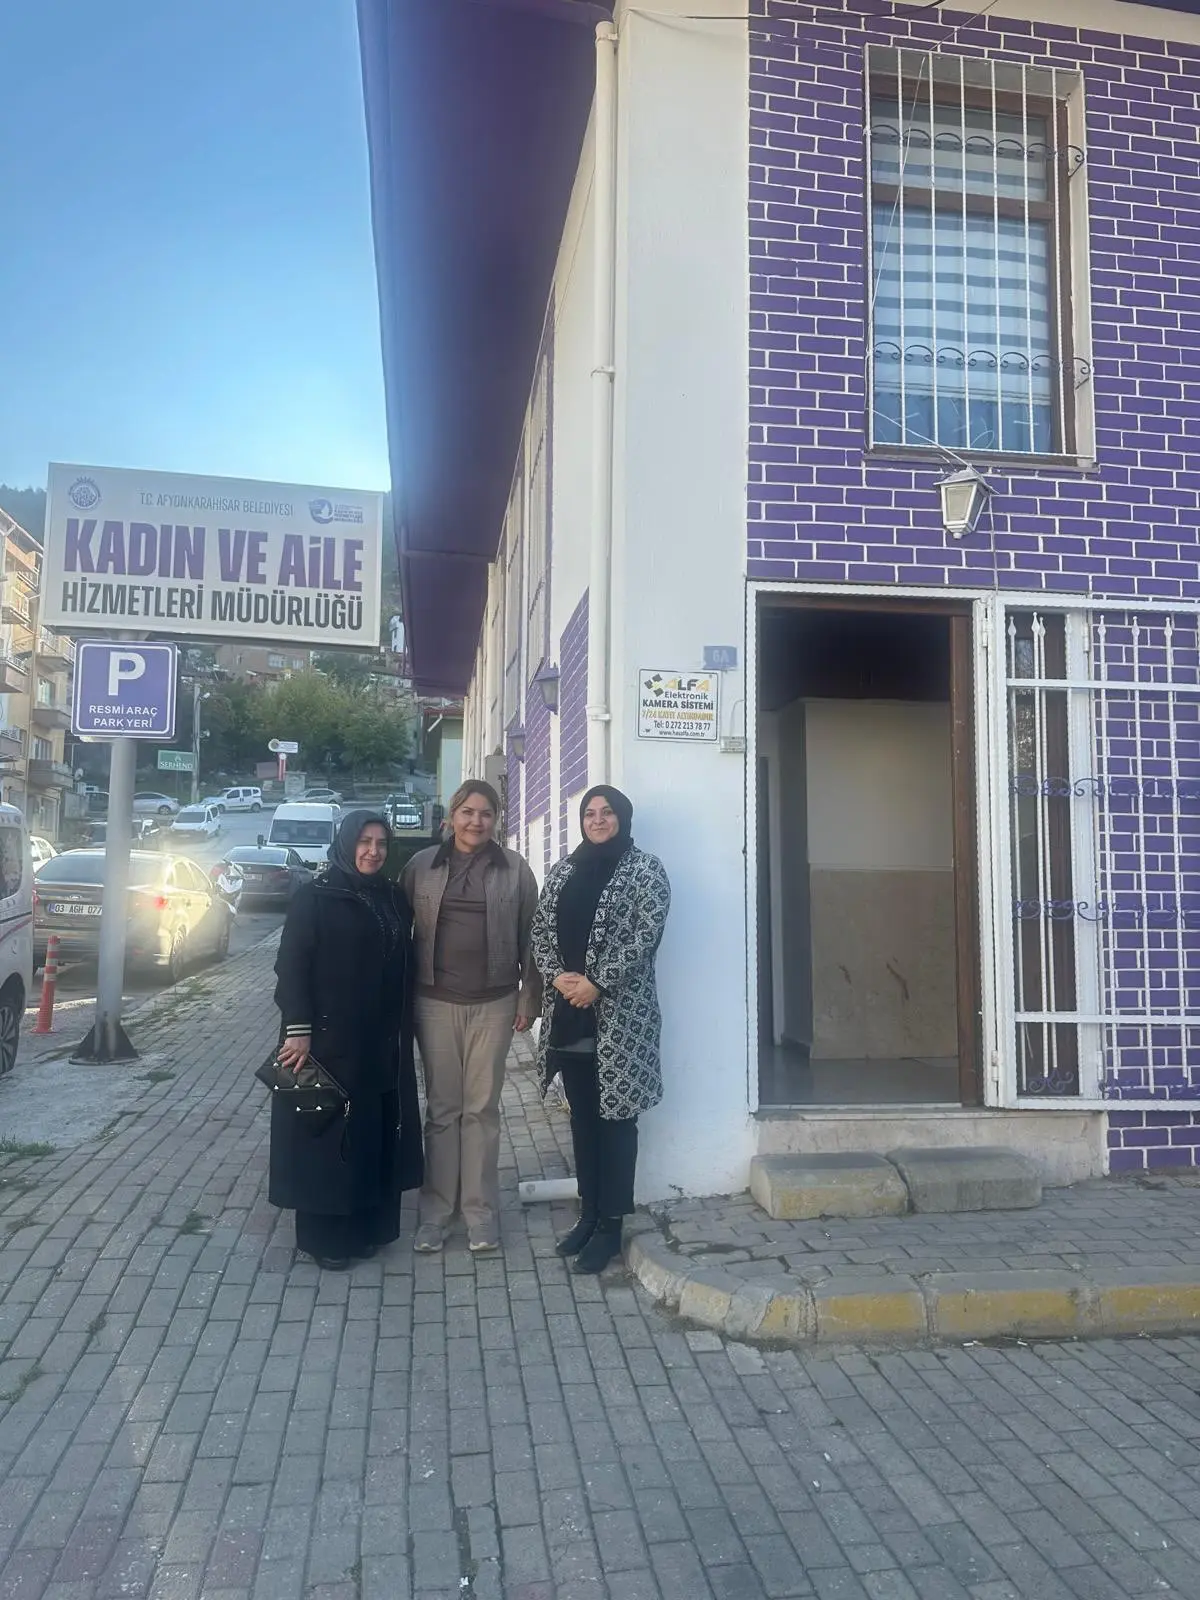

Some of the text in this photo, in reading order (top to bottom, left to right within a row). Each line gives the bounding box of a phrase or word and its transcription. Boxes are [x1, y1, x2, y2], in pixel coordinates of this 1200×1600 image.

[156, 493, 240, 512] AFYONKARAHİSAR
[63, 518, 363, 592] KADIN VE AİLE
[61, 576, 364, 631] HİZMETLERİ MÜDÜRLÜĞÜ
[108, 652, 146, 696] P
[664, 691, 708, 700] Elektronik
[89, 704, 158, 717] RESMİ ARAÇ
[642, 699, 714, 710] KAMERA SİSTEMİ
[93, 718, 152, 728] PARK YERİ
[670, 721, 681, 729] 272
[682, 721, 694, 730] 213
[703, 722, 711, 730] 77
